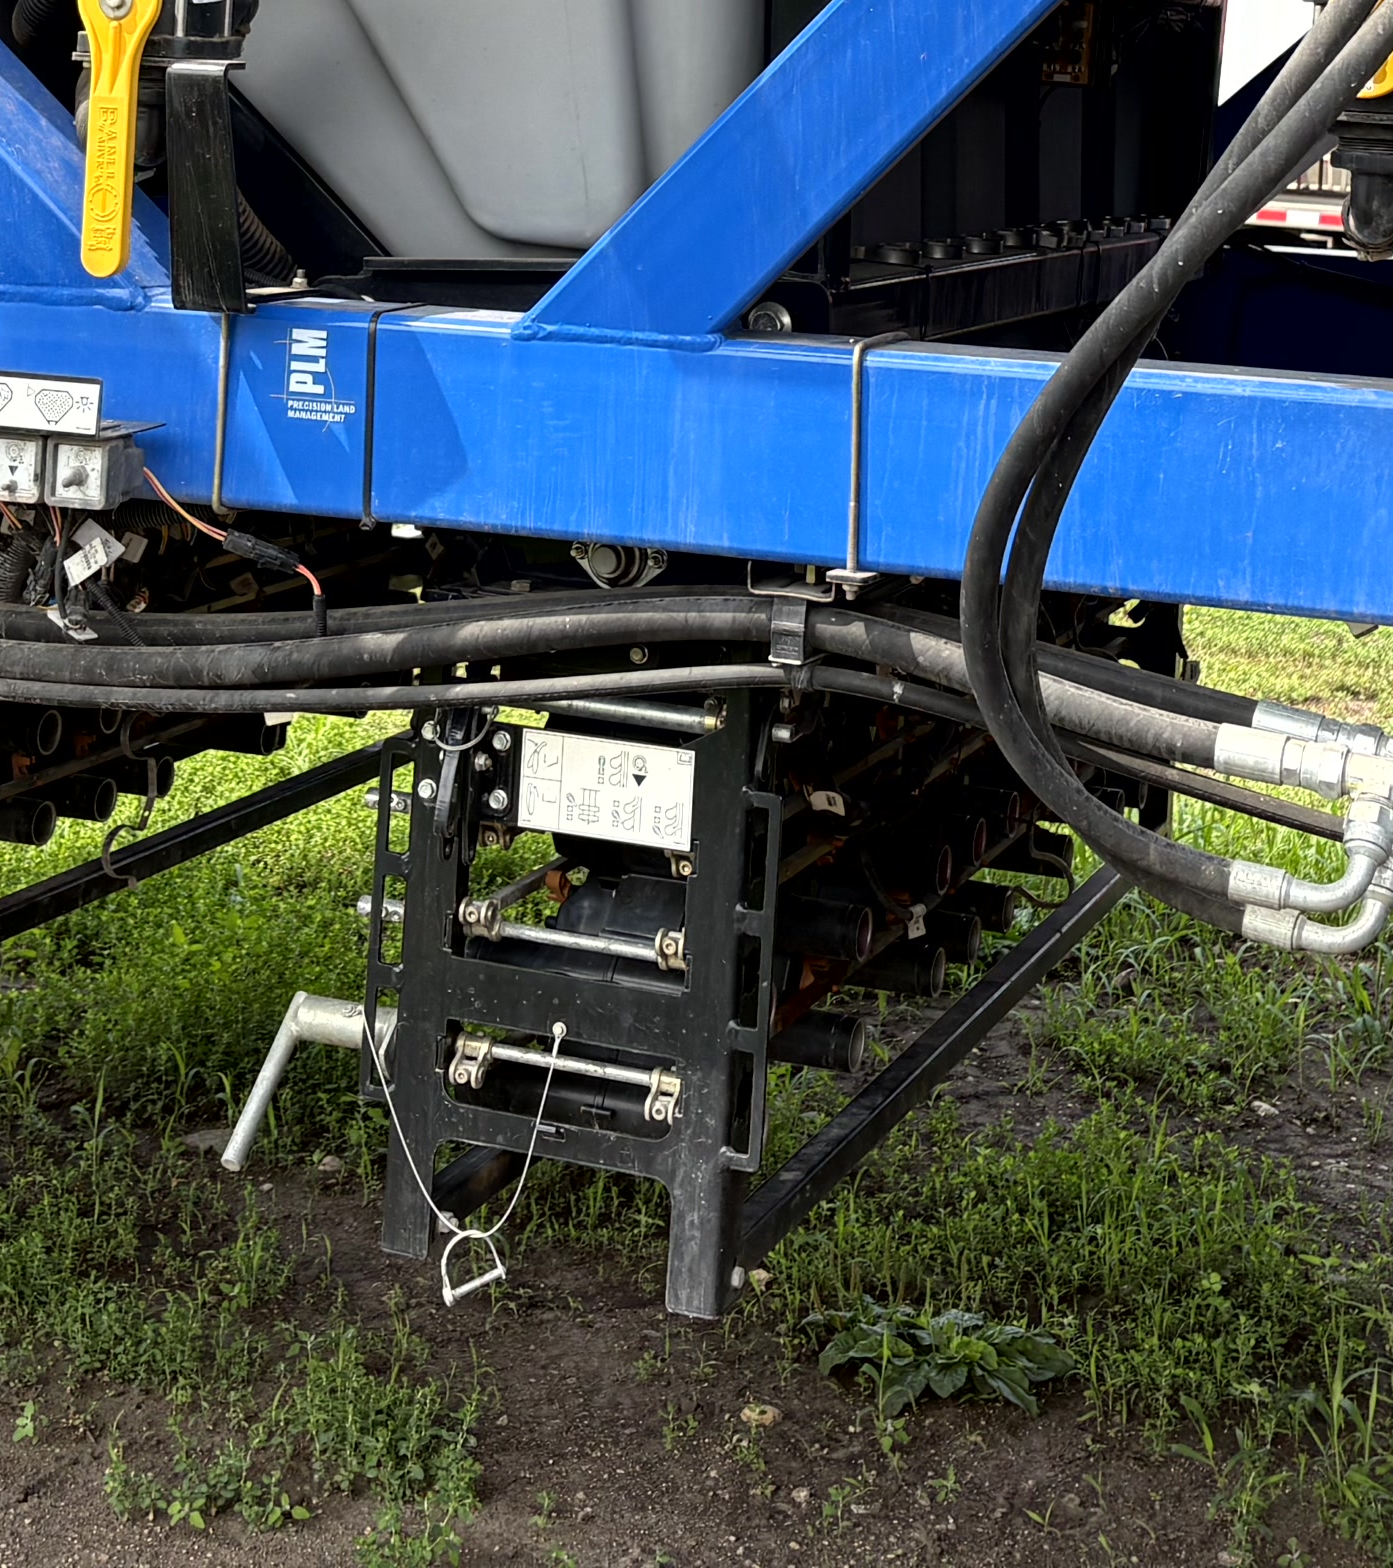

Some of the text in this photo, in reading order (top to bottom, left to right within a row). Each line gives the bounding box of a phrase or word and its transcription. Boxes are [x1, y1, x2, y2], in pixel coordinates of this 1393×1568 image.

[289, 328, 327, 395] PLM
[288, 400, 356, 414] PRECISION LAND
[287, 409, 346, 423] MANAGEMENT
